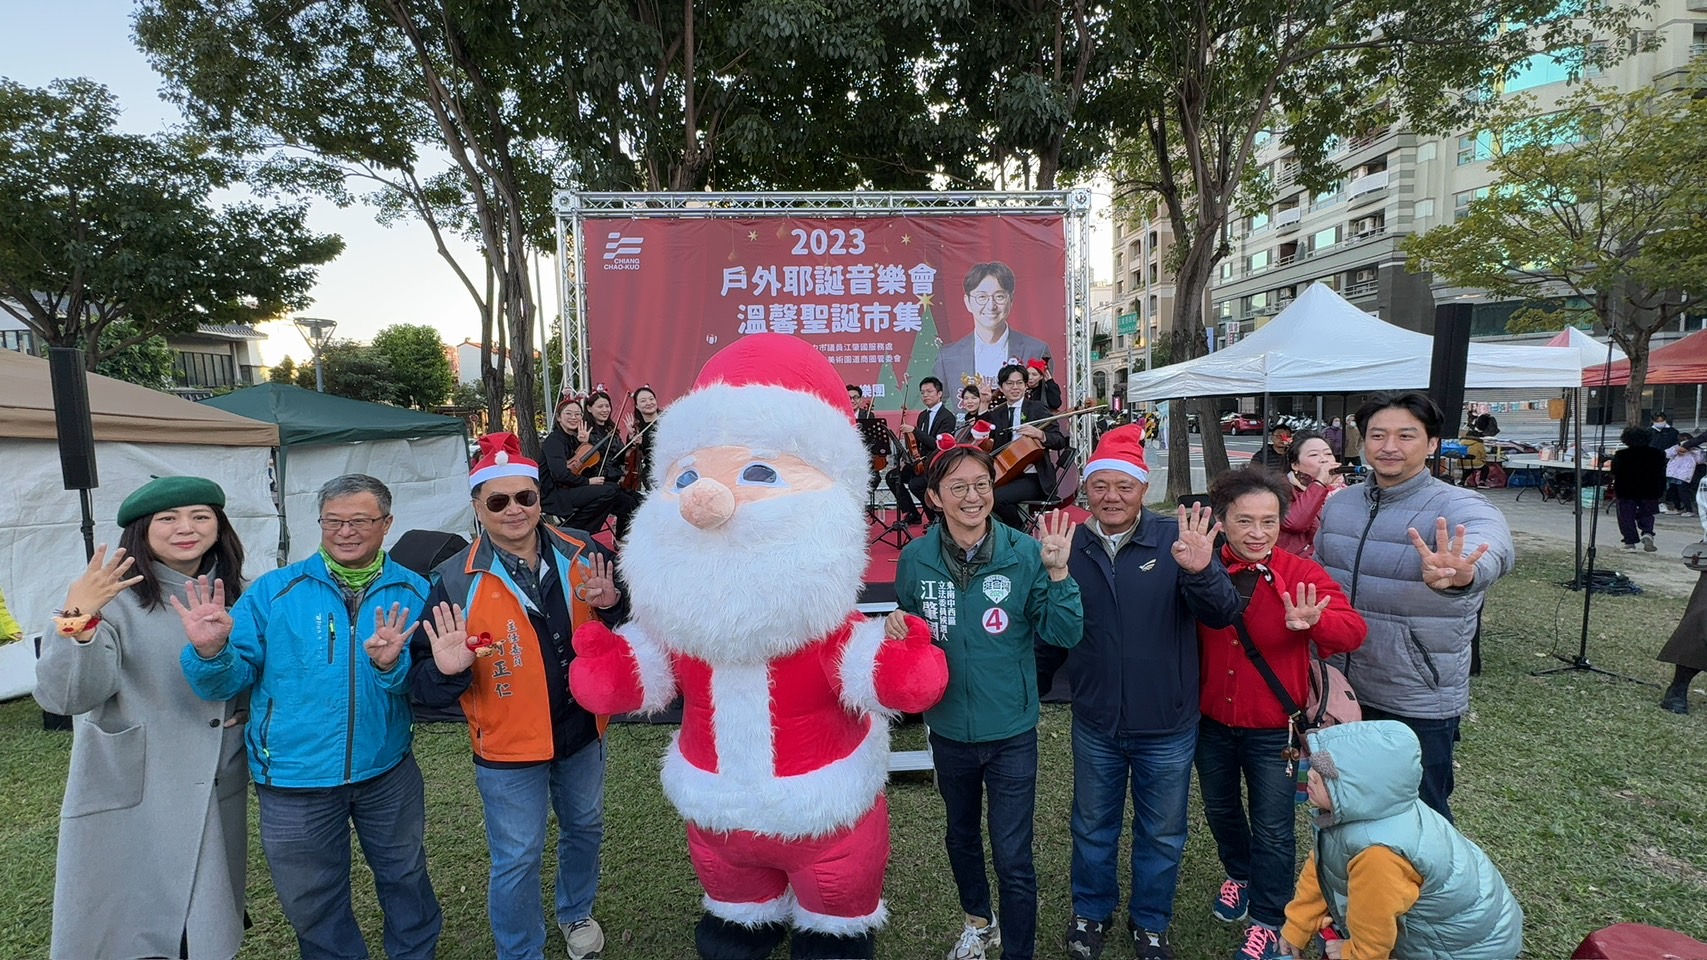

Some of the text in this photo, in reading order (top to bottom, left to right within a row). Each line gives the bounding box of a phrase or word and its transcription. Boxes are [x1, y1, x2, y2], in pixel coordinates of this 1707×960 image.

[791, 228, 866, 255] 2023
[720, 263, 937, 297] 戶外耶誕音樂會
[737, 302, 922, 334] 溫馨聖誕市集
[920, 580, 939, 641] 江肇國
[938, 581, 948, 641] 立法委員候選人
[985, 609, 1003, 630] 4
[507, 619, 522, 667] 主任委員
